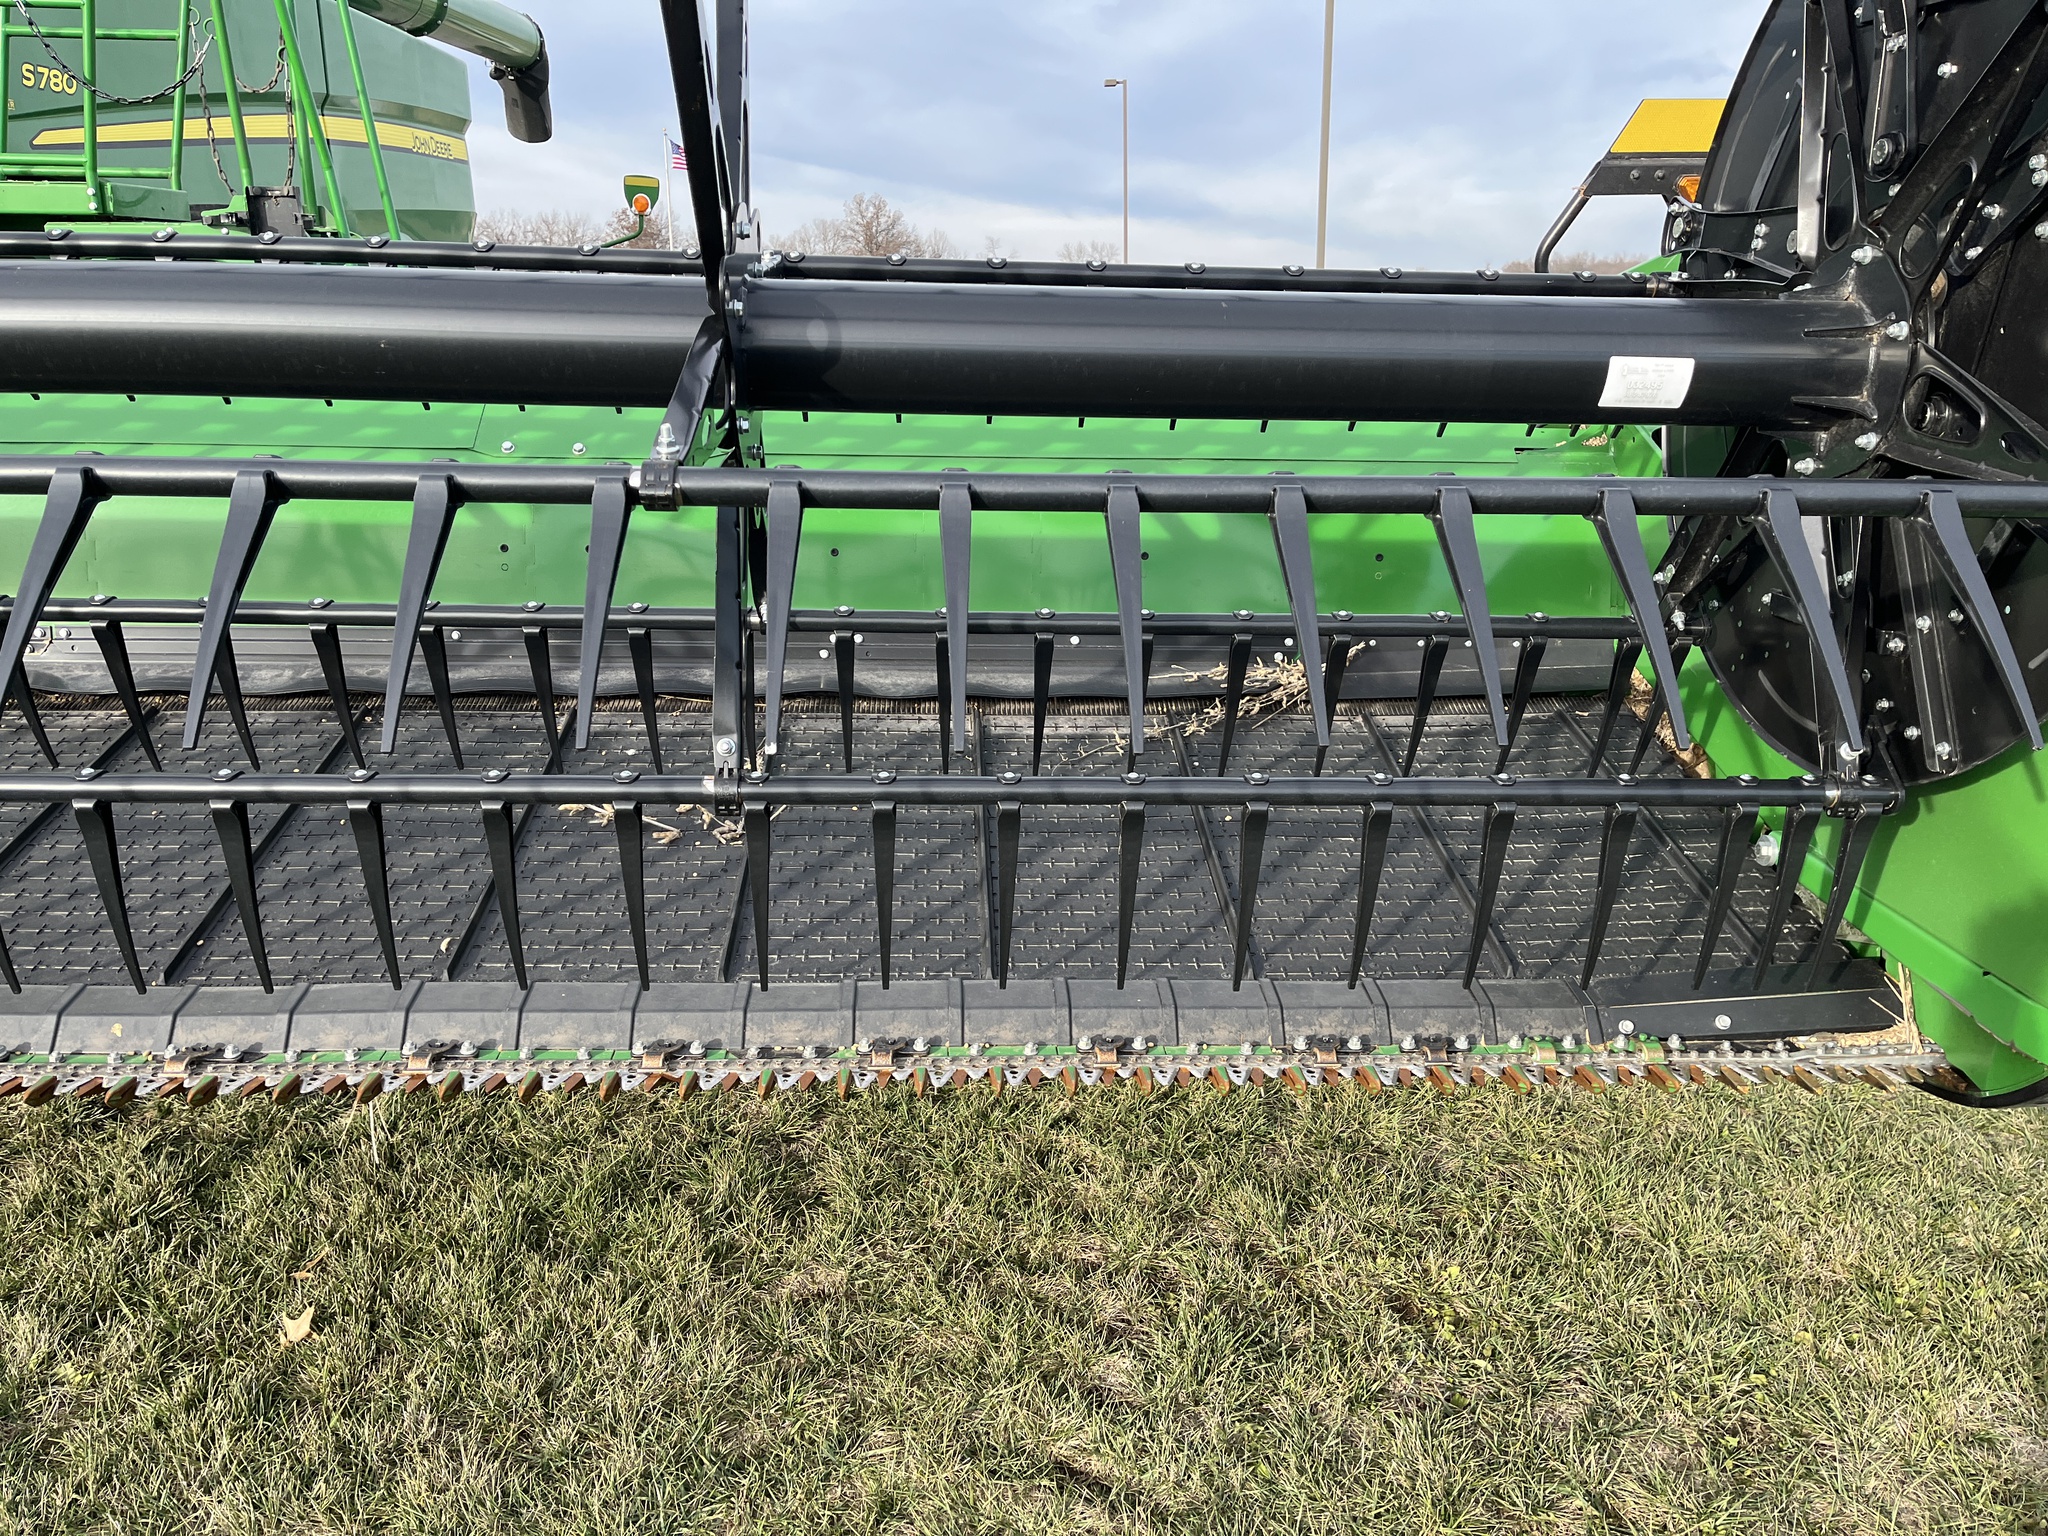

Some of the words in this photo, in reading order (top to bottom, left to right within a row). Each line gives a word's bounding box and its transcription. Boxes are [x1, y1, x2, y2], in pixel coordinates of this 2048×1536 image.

[21, 62, 78, 95] S780
[412, 132, 430, 154] JOHN
[430, 136, 454, 159] DEERE
